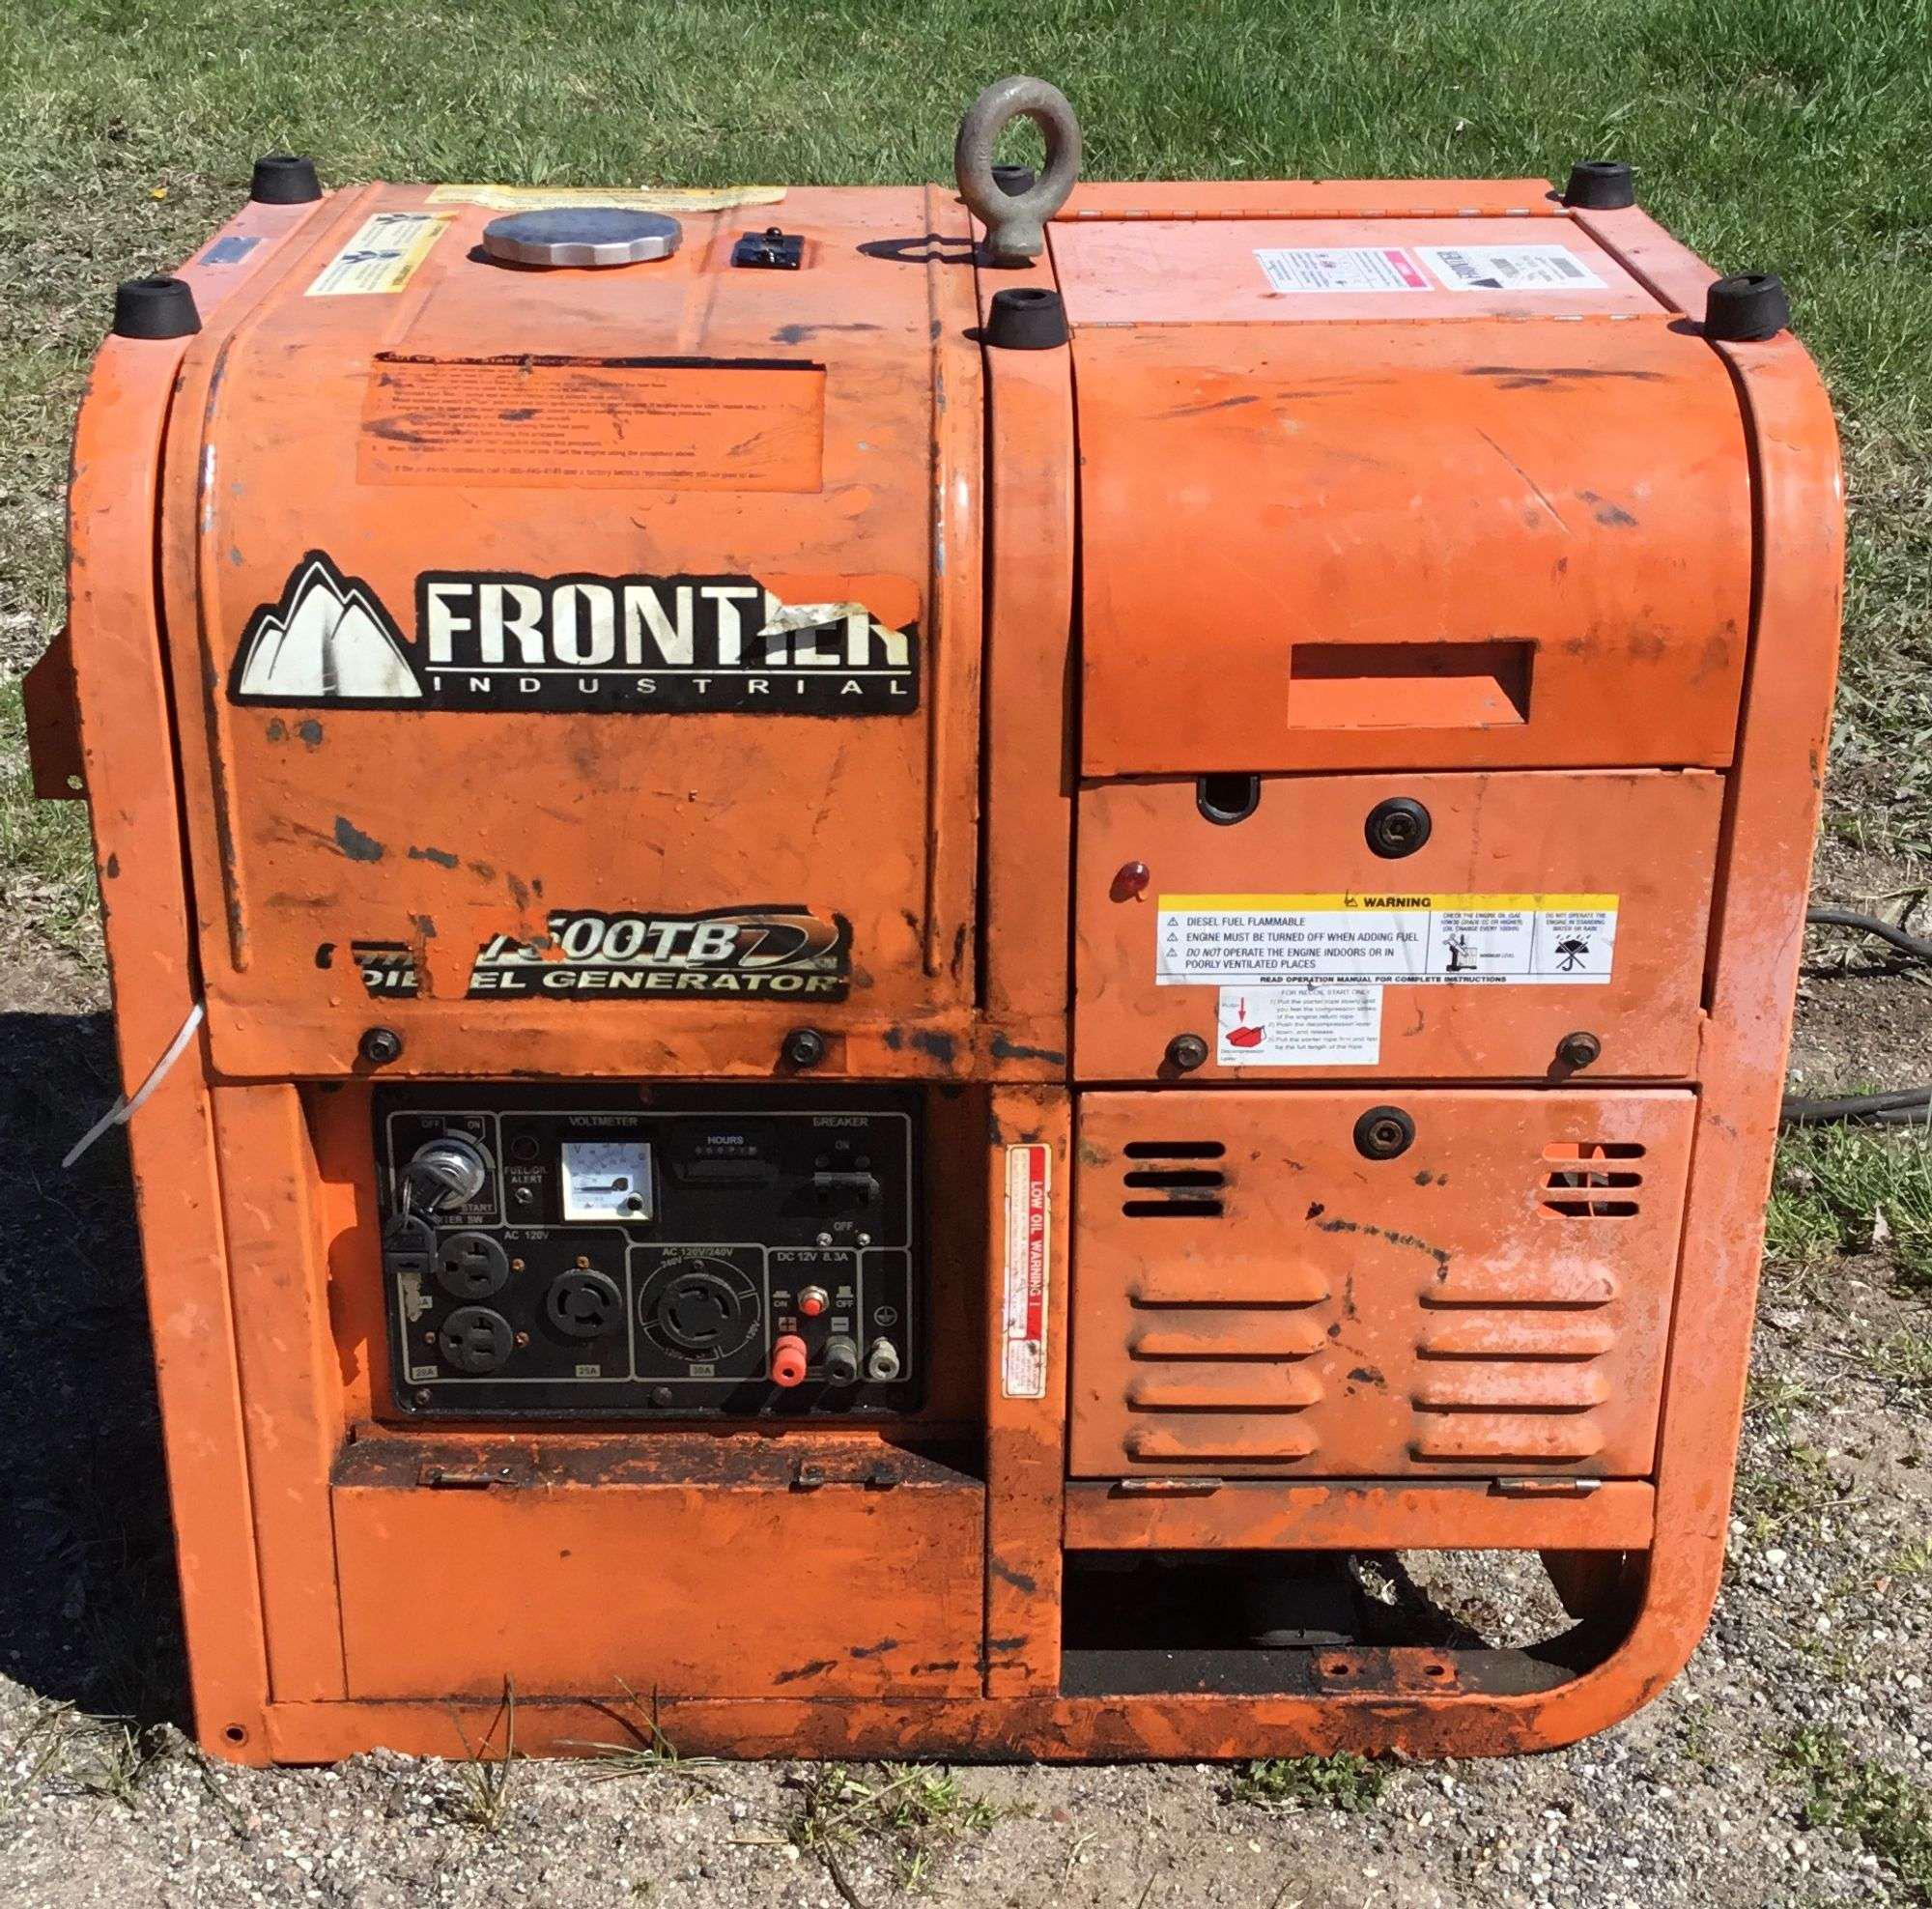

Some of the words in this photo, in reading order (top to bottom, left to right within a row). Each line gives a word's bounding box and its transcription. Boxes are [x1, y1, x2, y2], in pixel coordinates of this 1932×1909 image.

[433, 677, 908, 695] INDUSTRIAL
[1363, 898, 1432, 908] WARNING
[1186, 917, 1218, 926] DIESEL
[1222, 917, 1244, 926] FUEL
[1247, 917, 1306, 926] FLAMMABLE
[1186, 932, 1221, 942] ENGINE
[1223, 932, 1250, 942] MUST
[1253, 932, 1264, 942] BE
[1267, 932, 1305, 942] TURNED
[1307, 932, 1325, 942] OFF
[1327, 932, 1355, 942] WHEN
[1357, 932, 1393, 942] ADDING
[1396, 932, 1419, 942] FUEL
[1185, 948, 1200, 957] DO
[1202, 948, 1222, 957] NOT
[1223, 948, 1264, 957] OPERATE
[1267, 948, 1285, 957] THE
[1287, 948, 1321, 957] ENGINE
[1323, 948, 1366, 957] INDOORS
[1369, 948, 1382, 957] OR
[1384, 948, 1395, 957] IN
[1185, 959, 1221, 969] POORLY
[1223, 959, 1278, 969] VENTILATED
[1280, 959, 1316, 969] PLACES
[362, 969, 526, 989] DIEEL
[542, 971, 839, 992] GENERATOR
[421, 1120, 440, 1128] OFF
[467, 1121, 481, 1129] ON
[569, 1117, 639, 1126] VOLTMETER
[812, 1117, 869, 1127] BREAKER
[707, 1136, 744, 1145] HOURS
[835, 1140, 850, 1150] ON
[1030, 1181, 1043, 1209] LOW
[833, 1222, 853, 1231] OFF
[1030, 1214, 1043, 1235] OIL
[504, 1231, 520, 1240] AC
[777, 1252, 795, 1262] DC
[799, 1252, 817, 1262] 12V
[1030, 1239, 1042, 1296] WARNING
